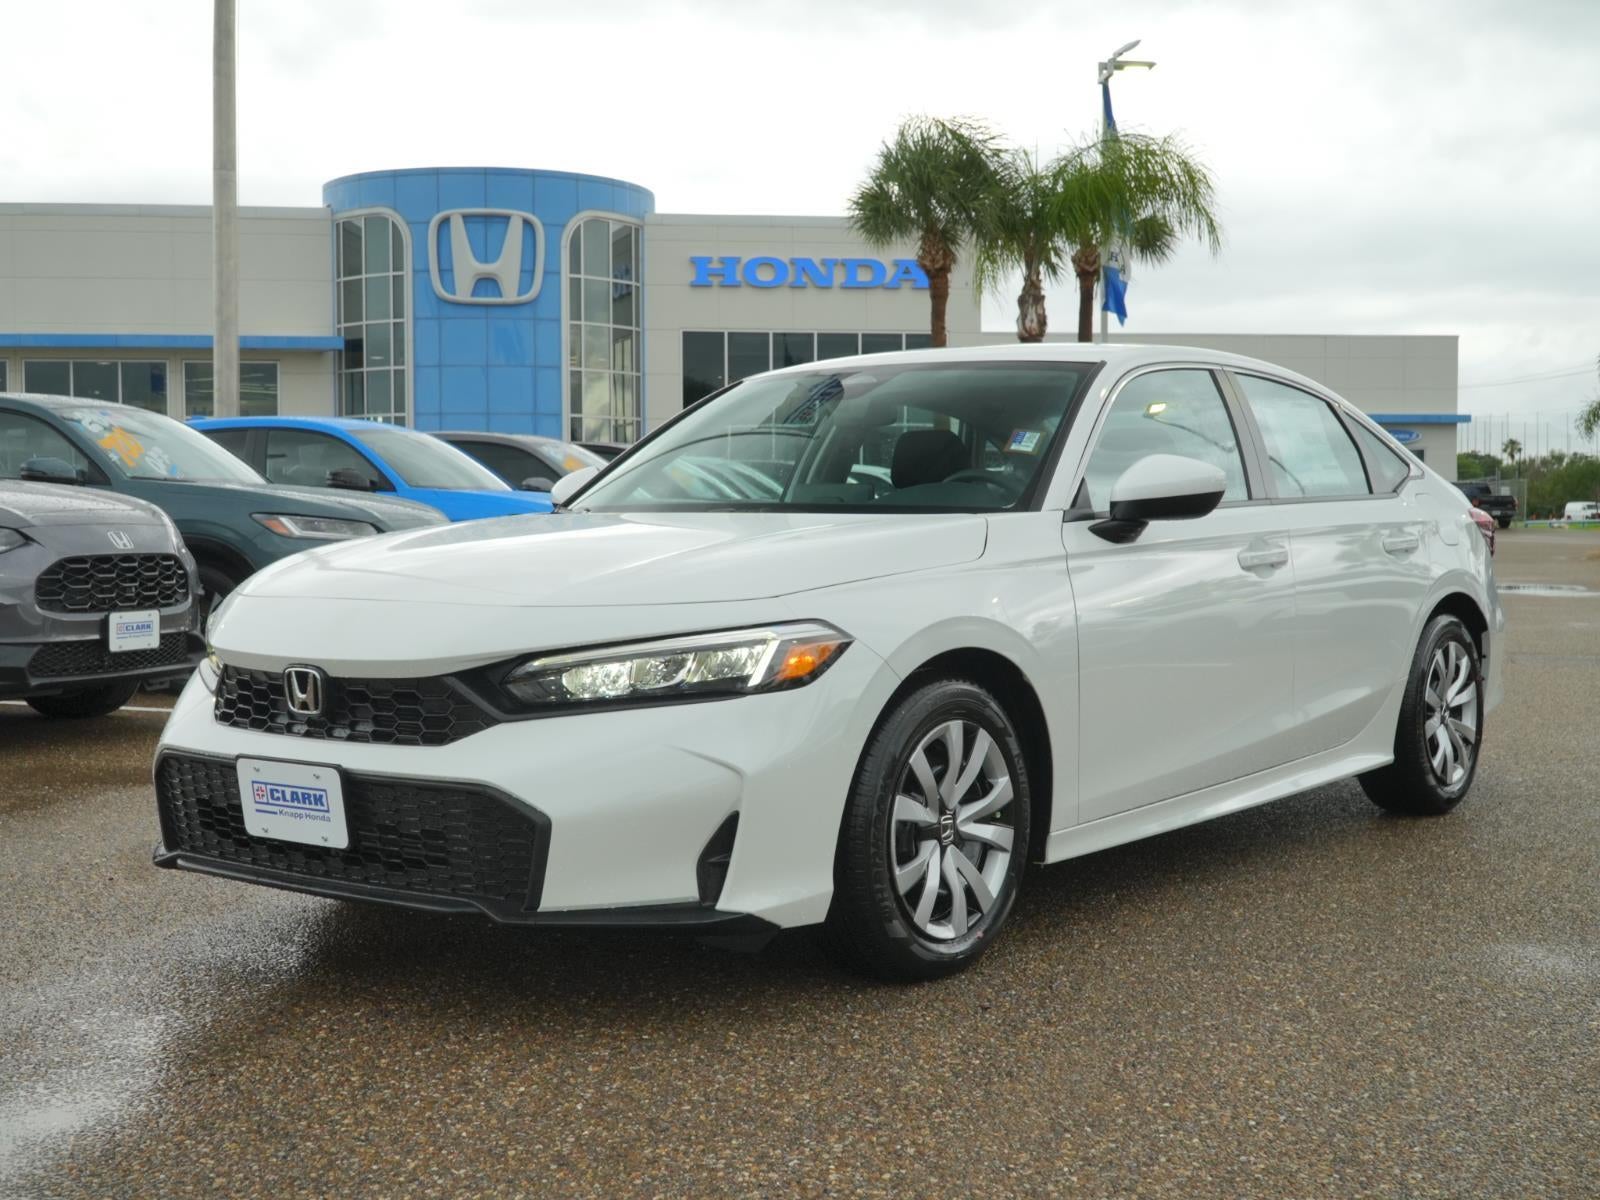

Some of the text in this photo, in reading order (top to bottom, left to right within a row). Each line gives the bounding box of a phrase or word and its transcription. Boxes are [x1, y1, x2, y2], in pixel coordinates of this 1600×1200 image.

[690, 256, 930, 289] HONDA
[269, 788, 326, 807] CLARK
[279, 809, 332, 822] Knapp Honda
